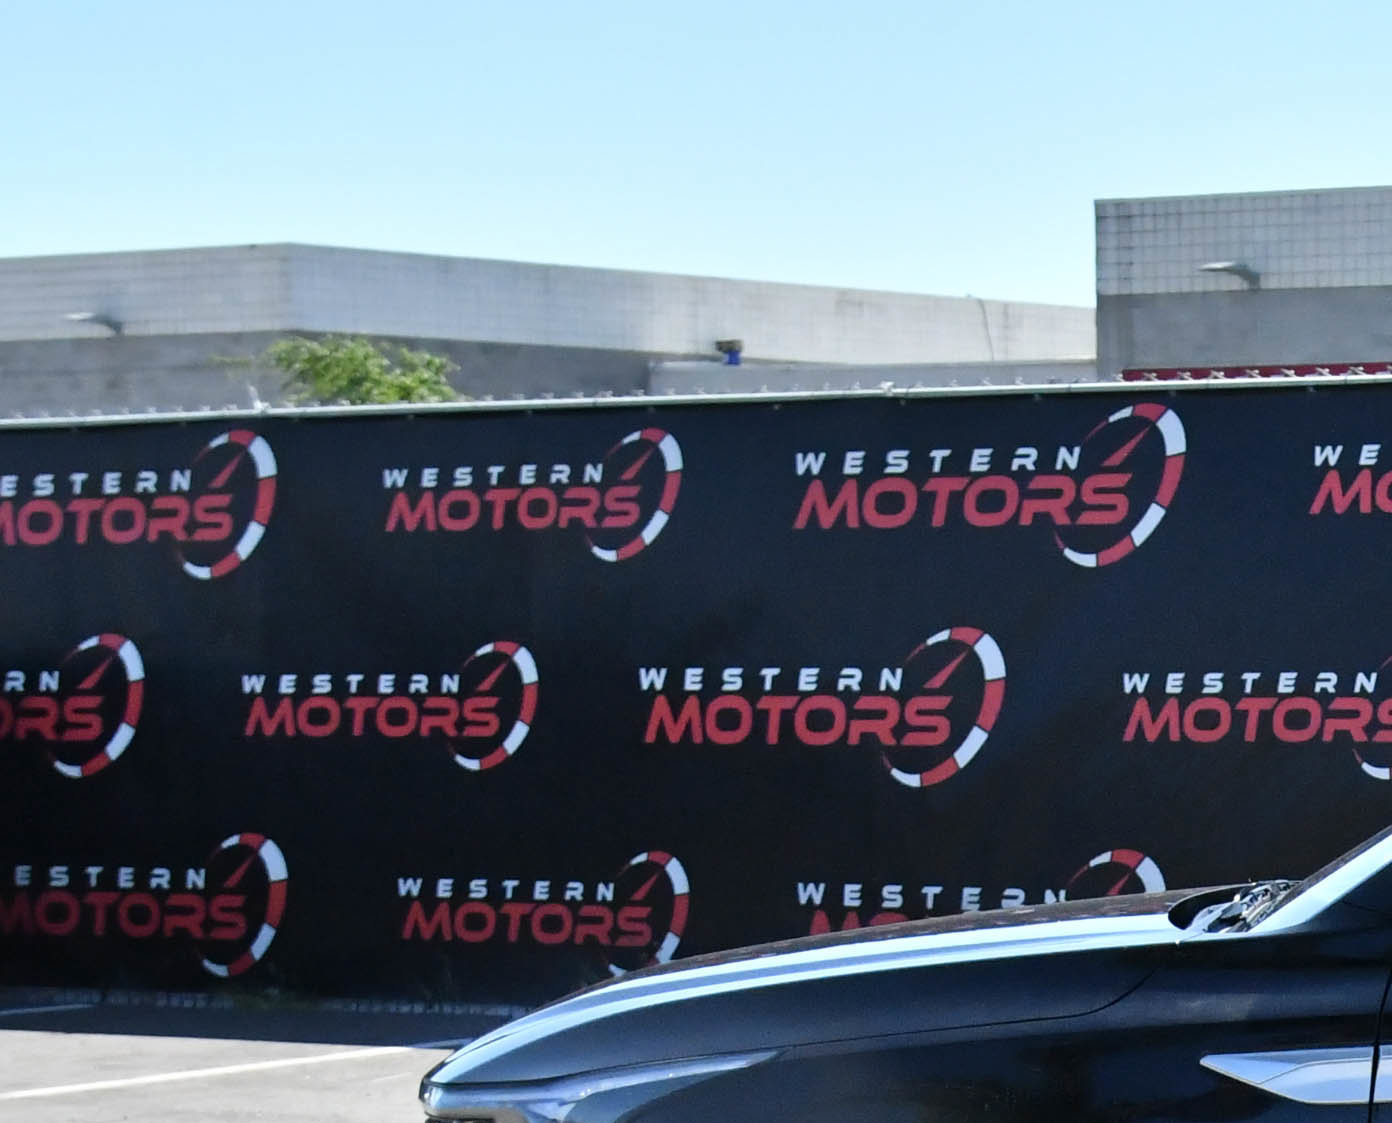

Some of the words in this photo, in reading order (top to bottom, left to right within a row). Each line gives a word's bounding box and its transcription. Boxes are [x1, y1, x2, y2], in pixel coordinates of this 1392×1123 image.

[795, 446, 1081, 476] WESTERN
[0, 469, 191, 497] ESTERN
[384, 463, 603, 489] WESTERN
[386, 485, 641, 532] MOTORS
[793, 472, 1133, 529] MOTORS
[242, 674, 460, 694] WESTERN
[639, 667, 903, 692] WESTERN
[1123, 671, 1378, 694] WESTERN
[245, 695, 501, 738] MOTORS
[644, 693, 953, 747] MOTORS
[15, 865, 206, 889] ESTERN
[398, 878, 615, 902] WESTERN
[402, 900, 653, 947] MOTORS
